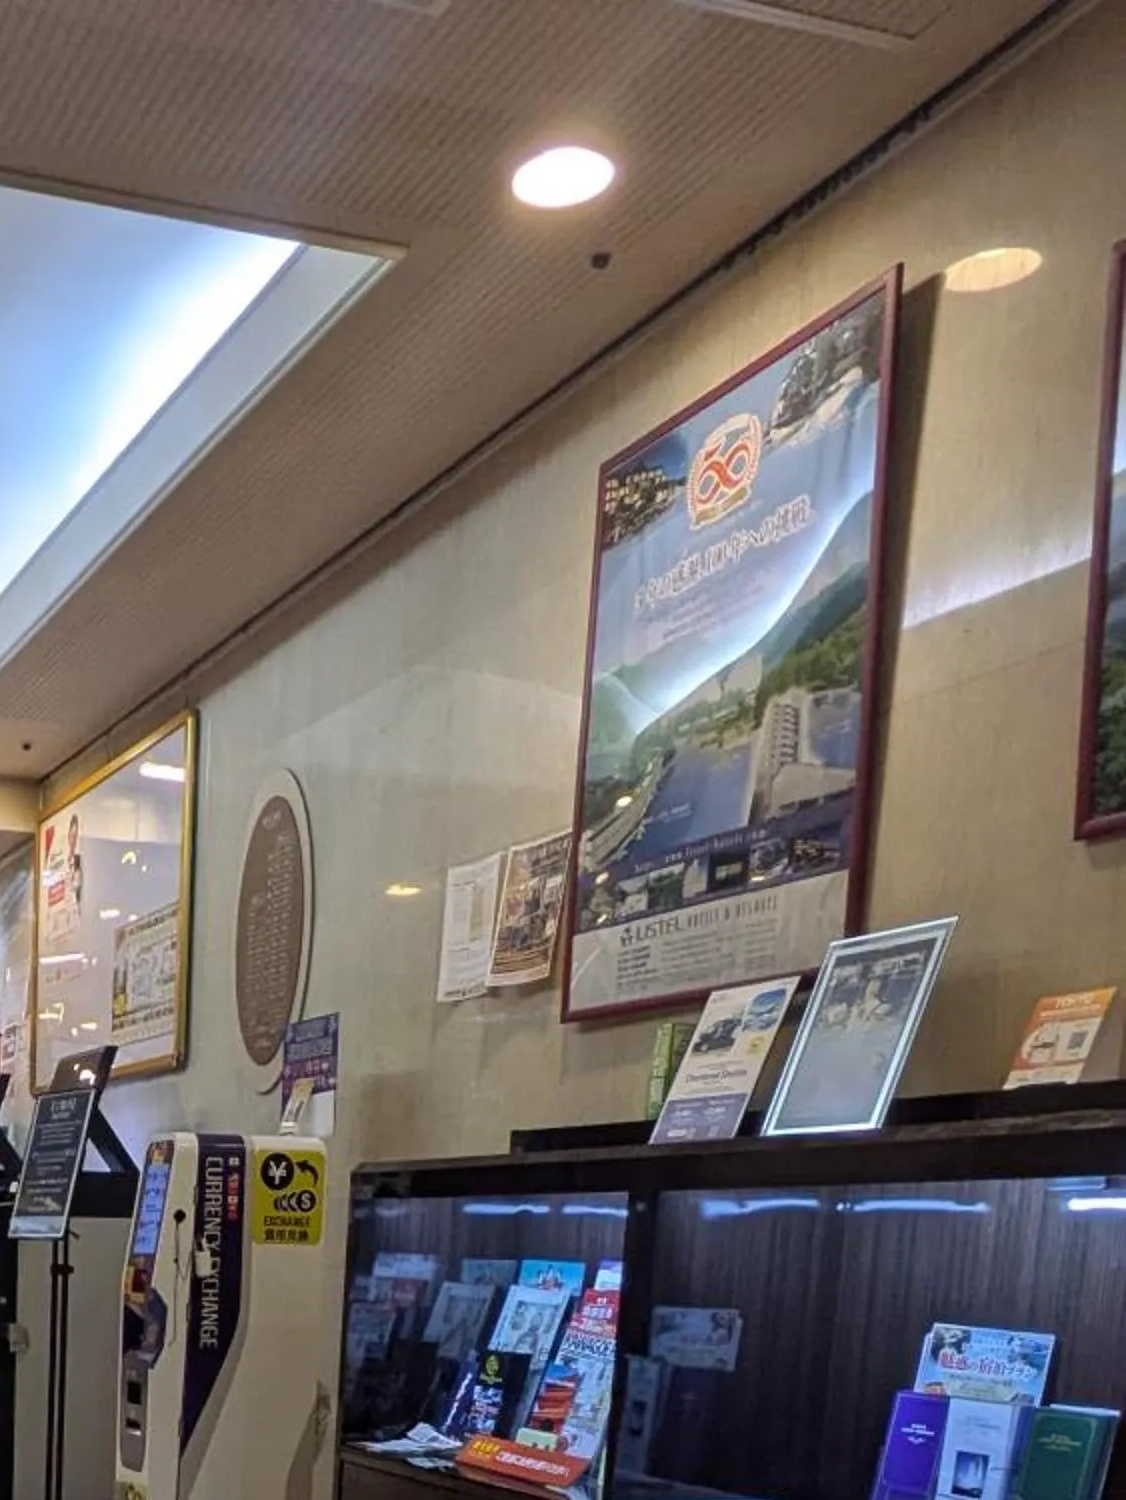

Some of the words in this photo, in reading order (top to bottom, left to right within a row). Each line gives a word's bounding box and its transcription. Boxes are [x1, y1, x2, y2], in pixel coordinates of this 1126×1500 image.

[636, 914, 685, 941] LISTEL
[203, 1156, 223, 1251] CURRENCY
[264, 1215, 311, 1228] EXCHANGE
